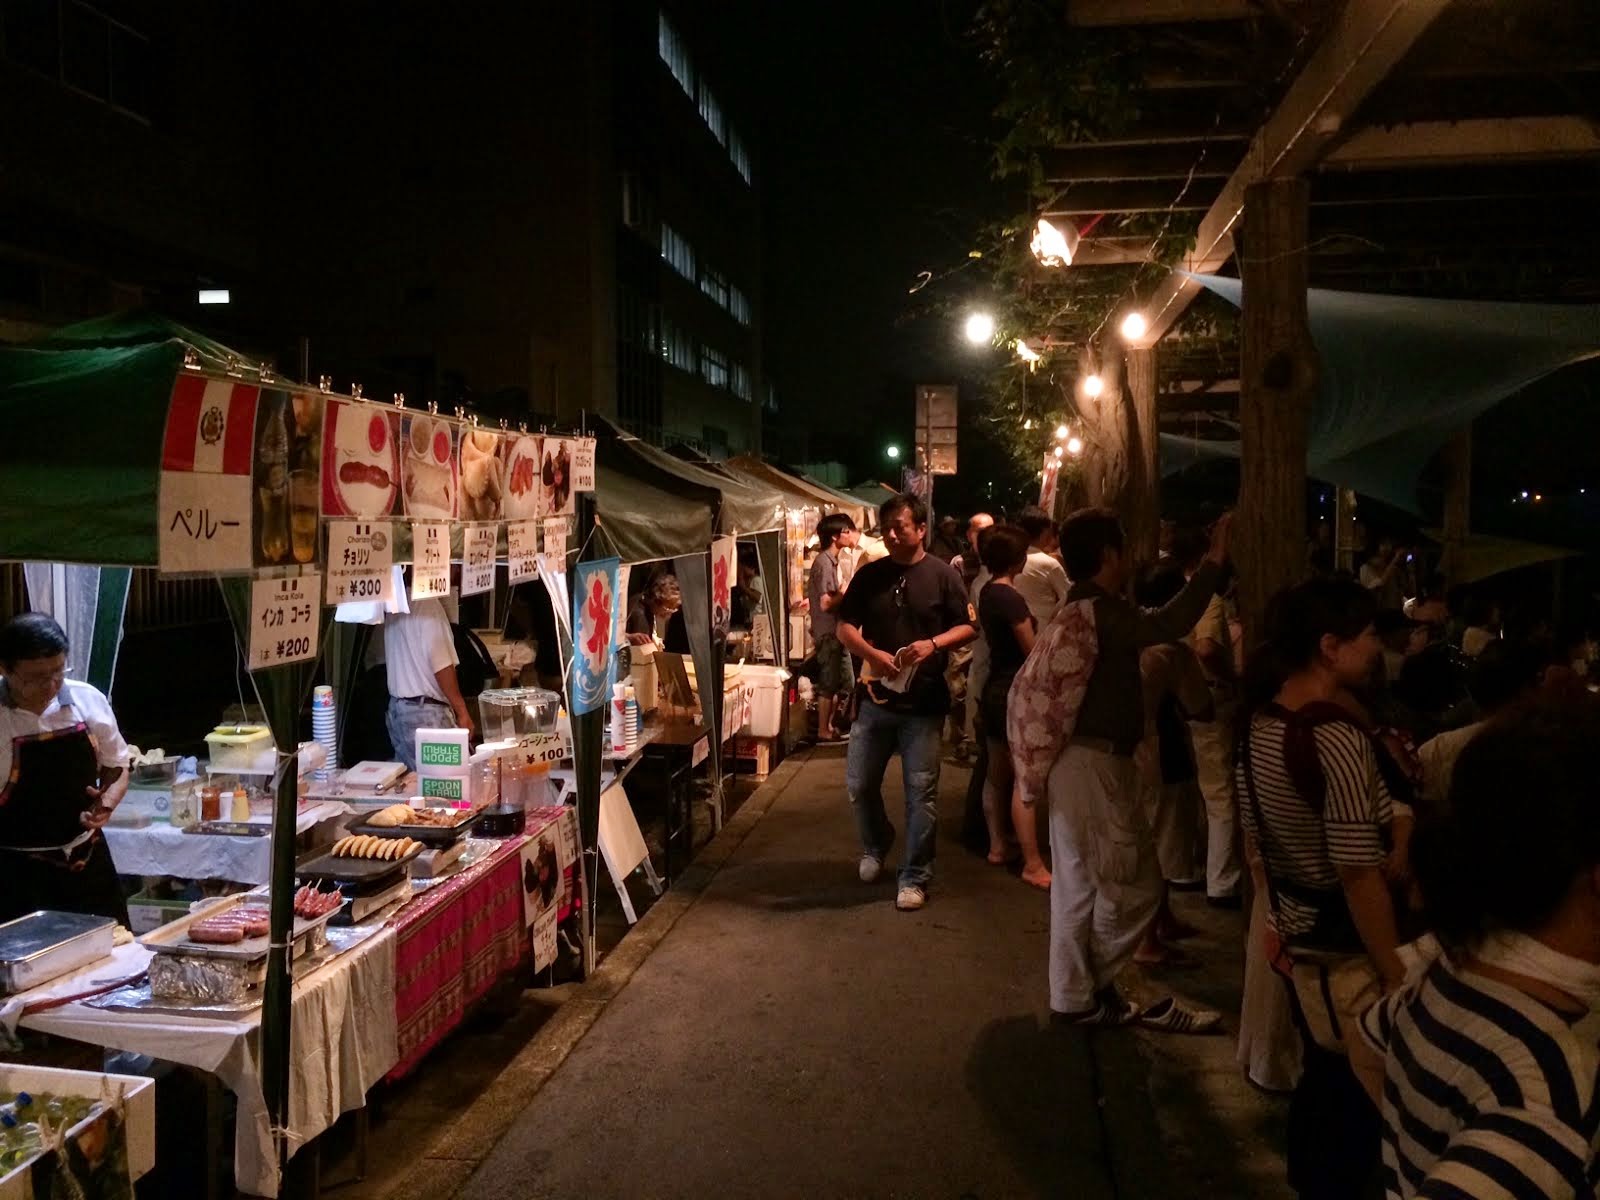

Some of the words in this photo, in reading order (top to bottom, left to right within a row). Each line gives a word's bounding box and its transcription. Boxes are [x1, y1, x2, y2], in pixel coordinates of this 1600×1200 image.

[169, 508, 240, 540] ペルー
[519, 560, 538, 574] ¥200
[349, 578, 382, 597] ¥300
[429, 577, 447, 593] ¥400
[274, 593, 289, 601] Inca
[290, 592, 304, 600] Kola
[261, 606, 284, 628] インカ
[290, 604, 311, 623] コーラ
[276, 636, 310, 659] ¥200
[422, 745, 460, 755] STRAW
[422, 753, 460, 764] SPOON
[424, 780, 461, 791] SPOON
[424, 788, 461, 798] STRAW
